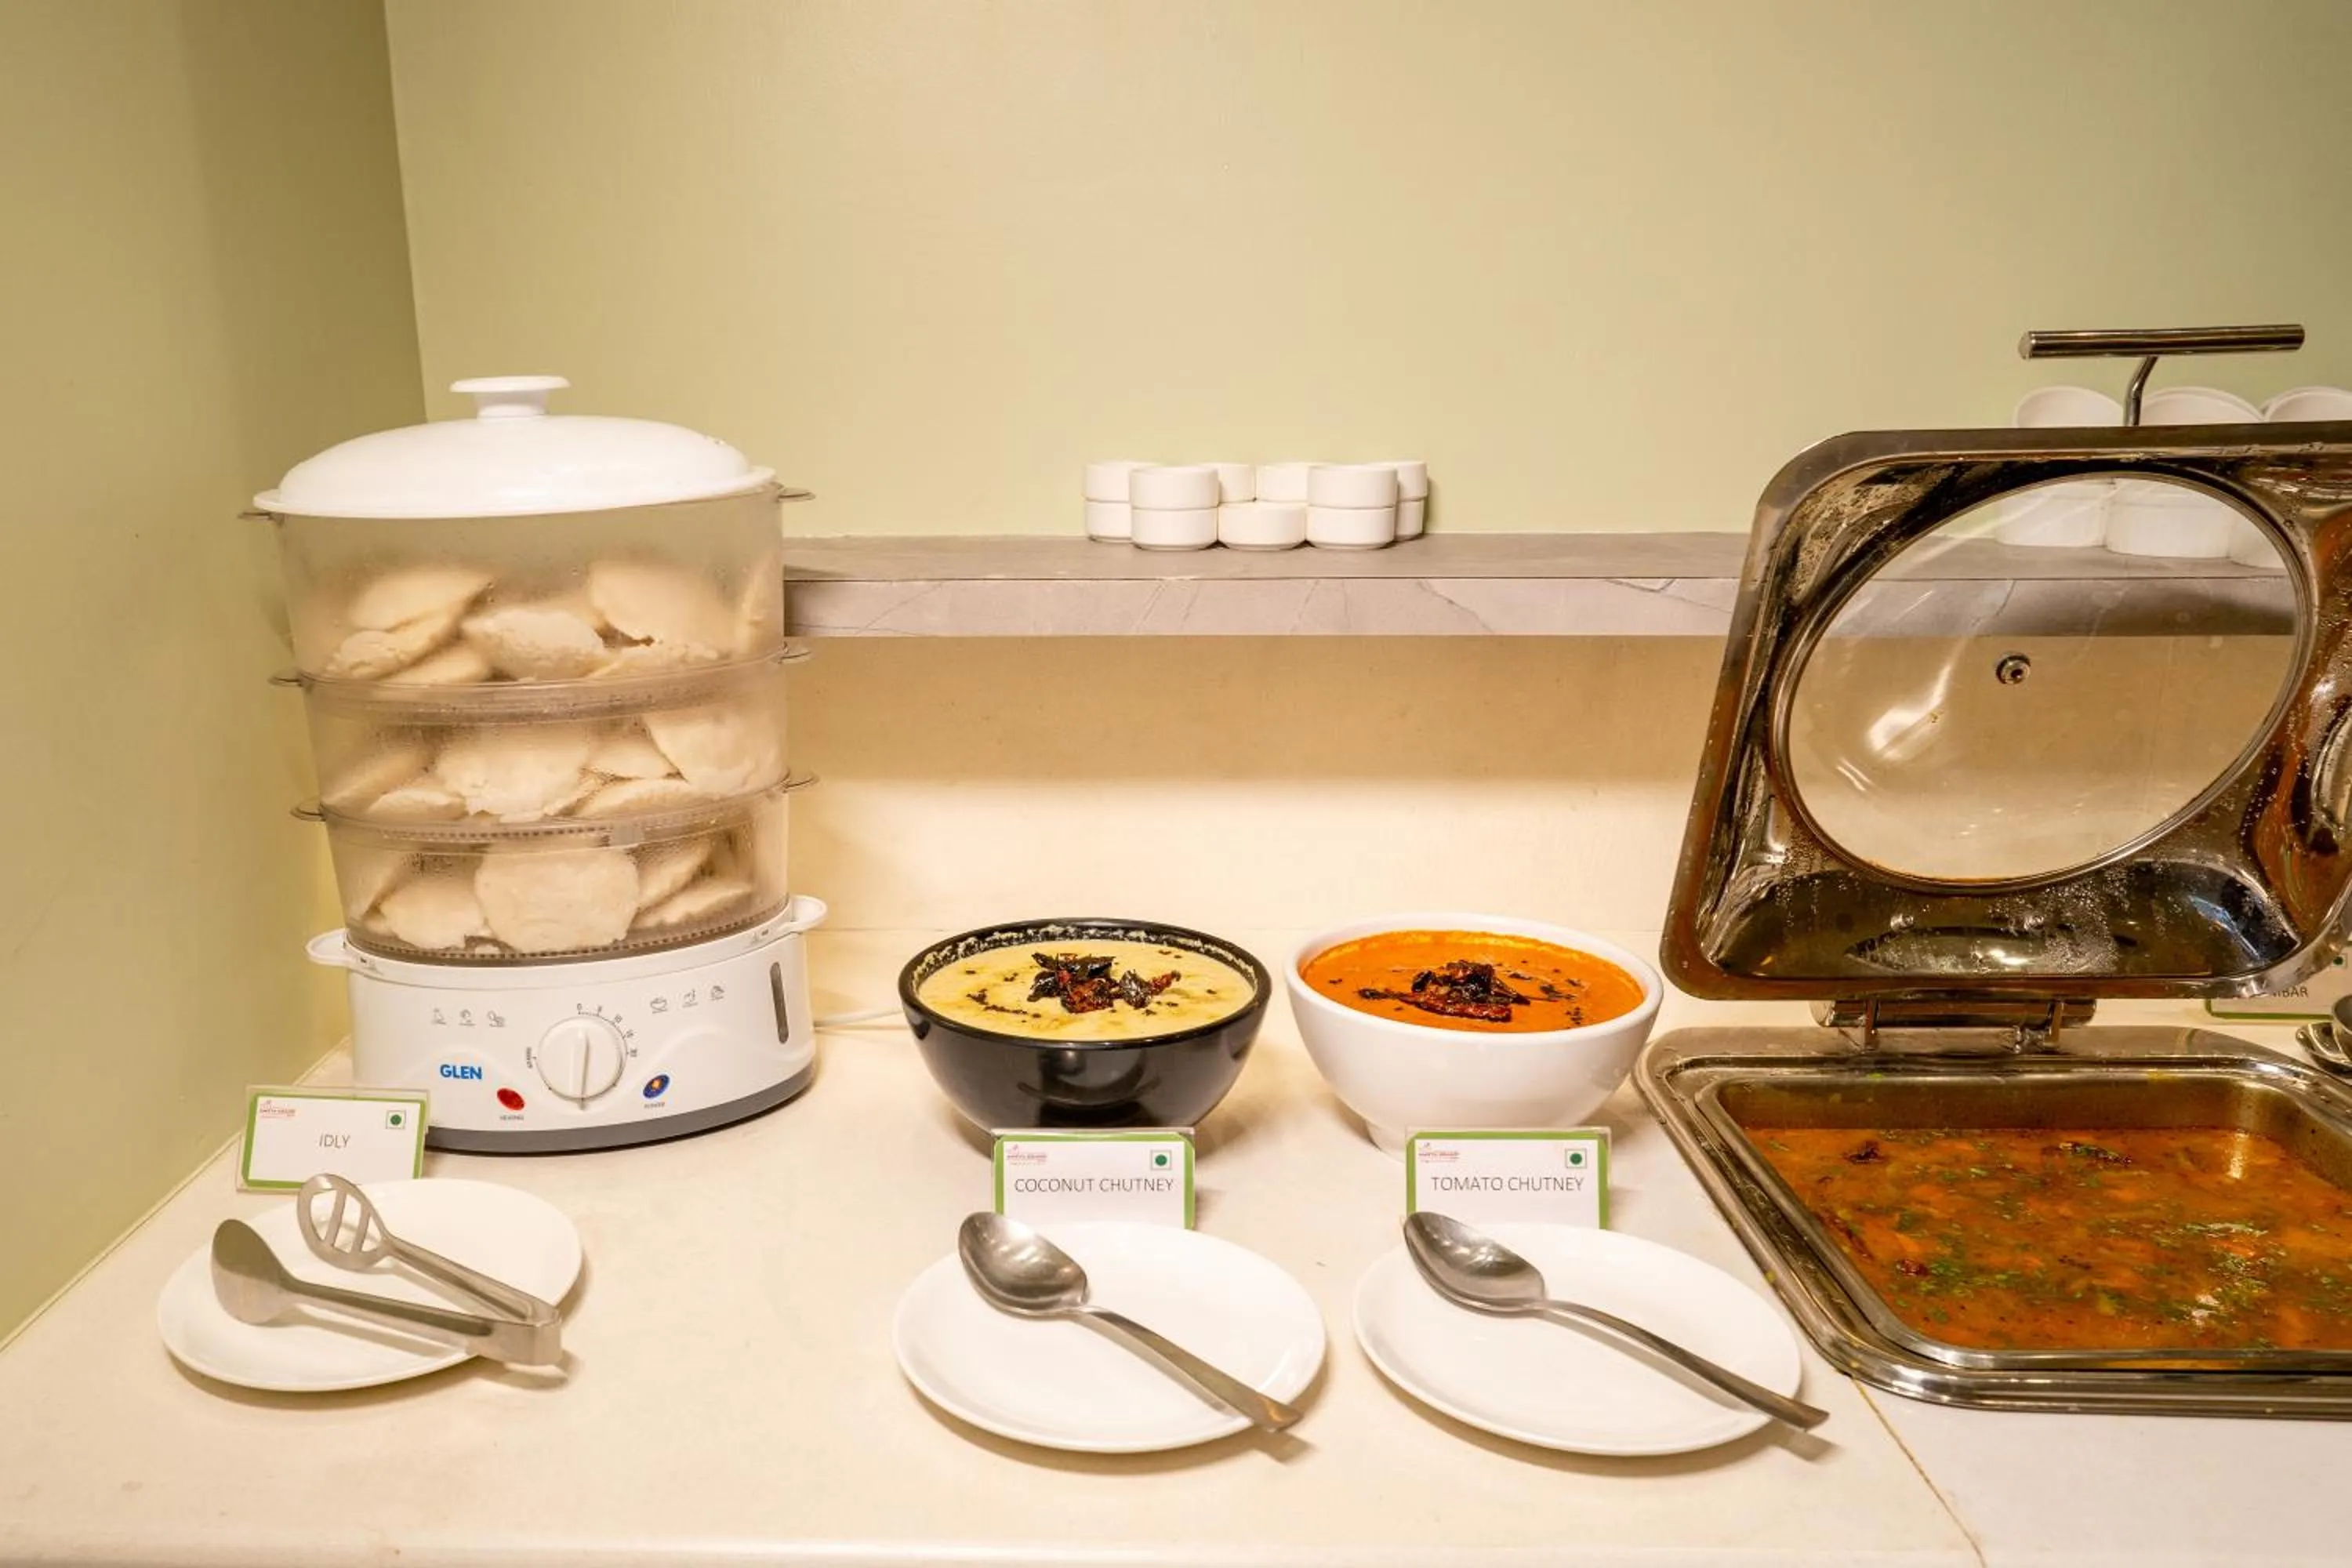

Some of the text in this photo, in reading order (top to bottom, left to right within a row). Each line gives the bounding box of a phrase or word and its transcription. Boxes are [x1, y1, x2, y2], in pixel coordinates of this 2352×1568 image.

[440, 1064, 482, 1080] GLEN
[319, 1134, 350, 1149] IDLY
[1014, 1178, 1174, 1192] COCONUT CHUTNEY
[1432, 1177, 1584, 1191] TOMATO CHUTNEY
